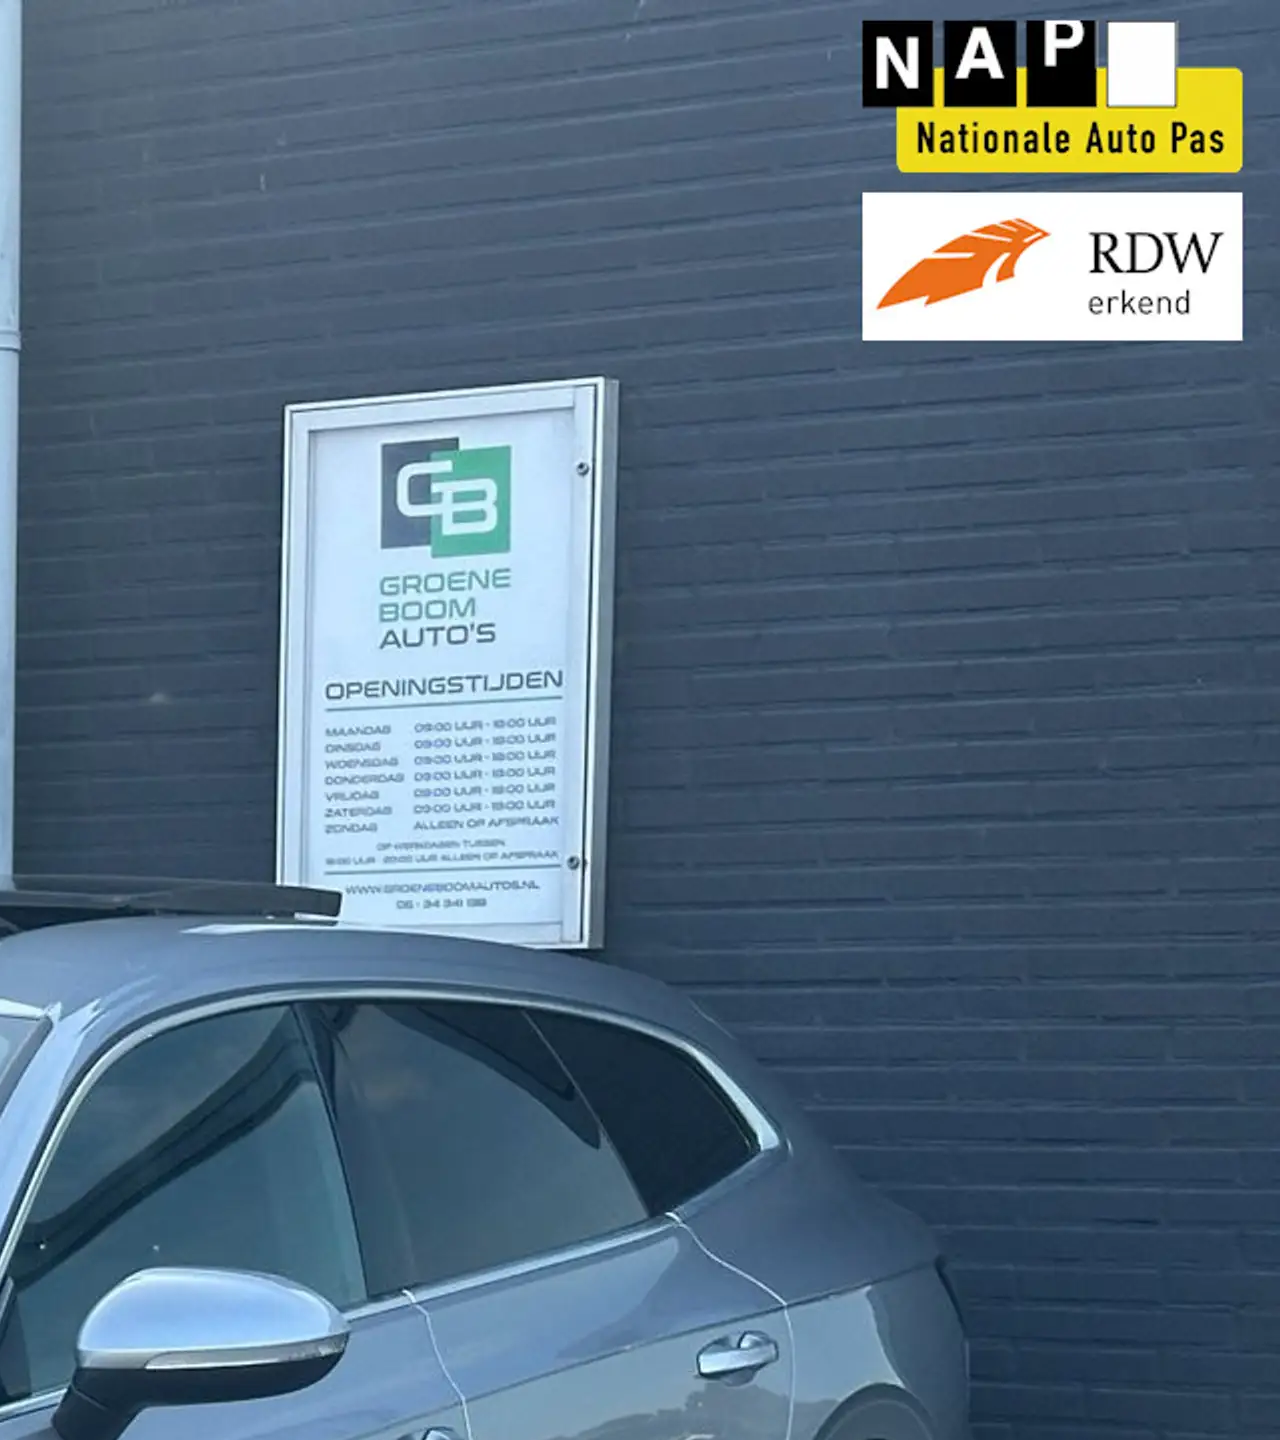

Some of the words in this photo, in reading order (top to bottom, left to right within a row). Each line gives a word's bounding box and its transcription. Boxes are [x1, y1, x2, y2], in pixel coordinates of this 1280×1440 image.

[379, 568, 512, 596] GROENE
[379, 597, 476, 623] BOOM
[379, 622, 496, 650] AUTO'S
[325, 670, 563, 701] OPENINGSTIJDEN
